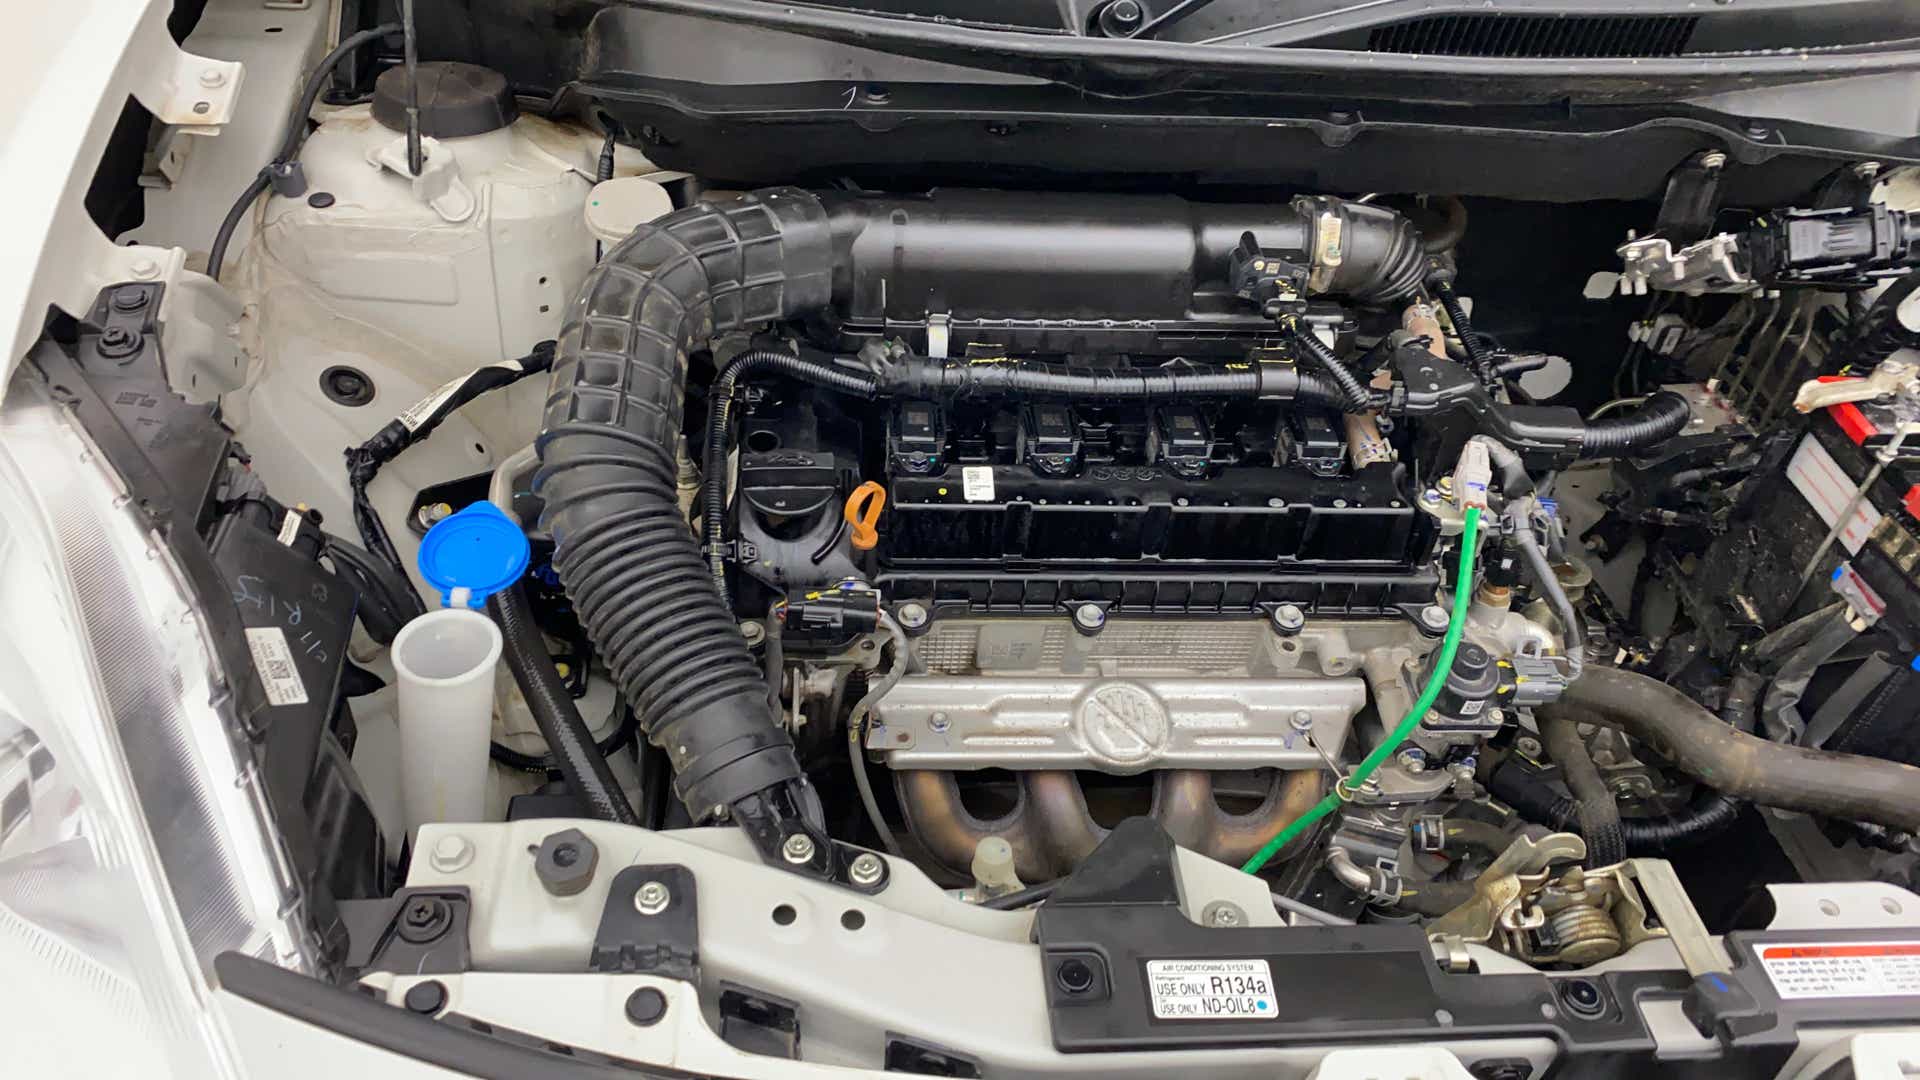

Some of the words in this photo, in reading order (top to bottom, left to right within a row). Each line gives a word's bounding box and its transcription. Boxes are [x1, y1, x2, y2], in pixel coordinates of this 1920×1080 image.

[1157, 983, 1176, 995] USE
[1179, 983, 1205, 995] ONLY
[1210, 976, 1267, 994] R134a
[1160, 1004, 1175, 1014] USE
[1178, 1004, 1197, 1014] ONLY
[1202, 997, 1256, 1014] ND-OIL8
